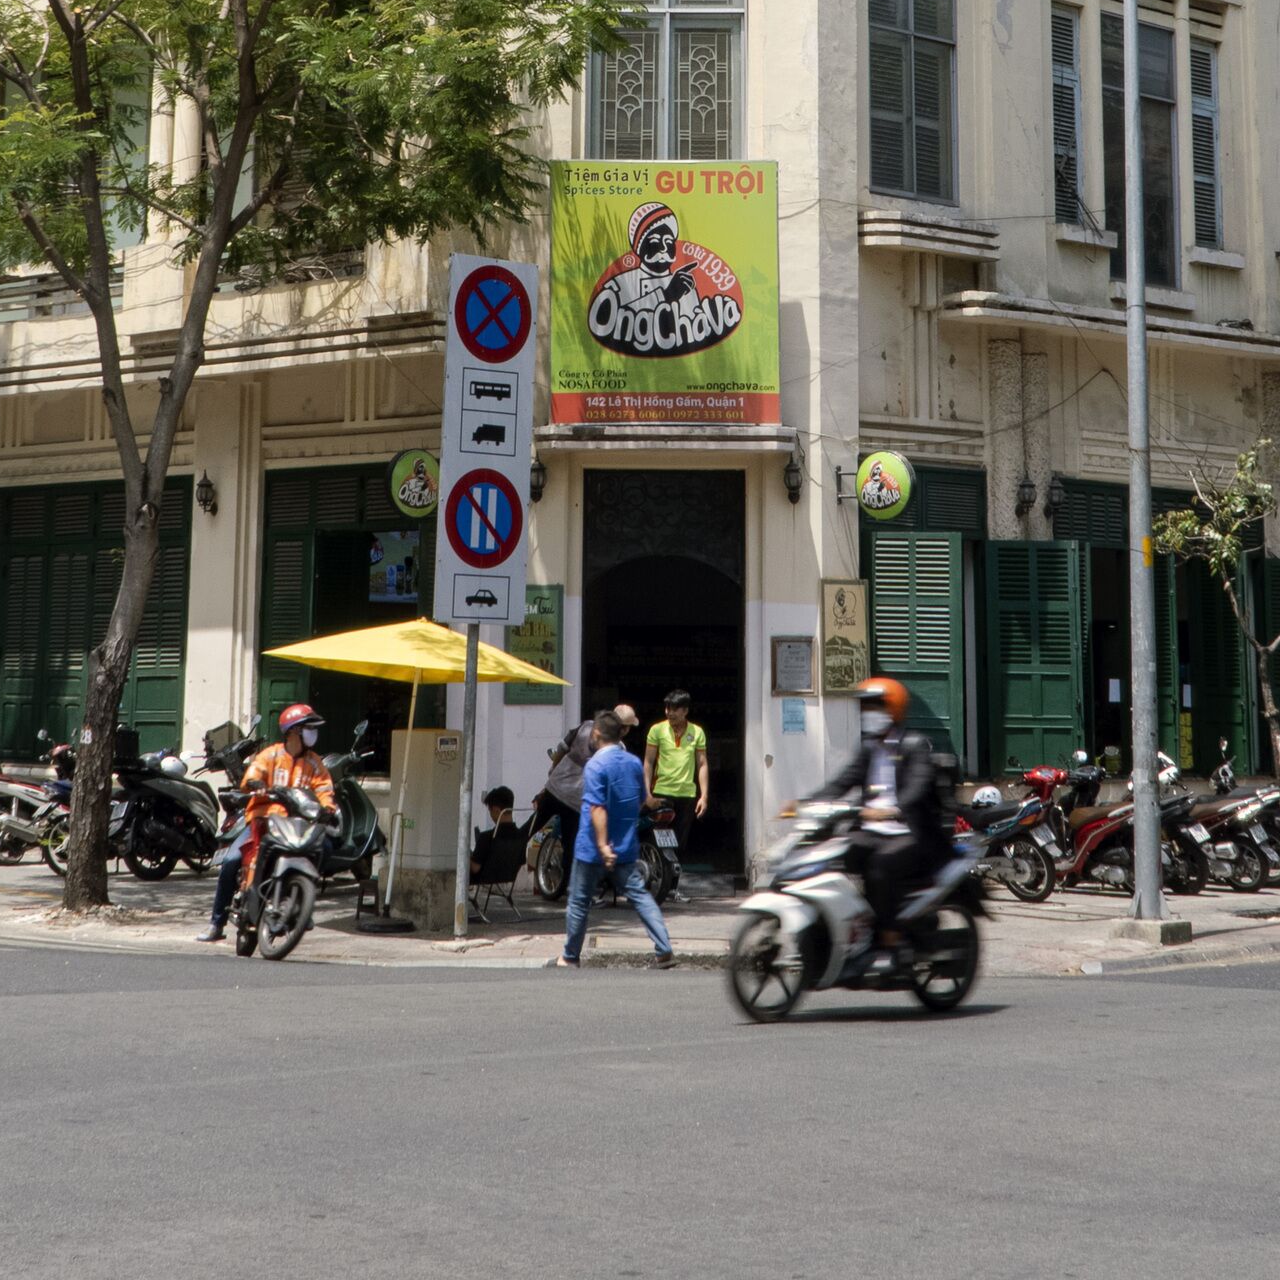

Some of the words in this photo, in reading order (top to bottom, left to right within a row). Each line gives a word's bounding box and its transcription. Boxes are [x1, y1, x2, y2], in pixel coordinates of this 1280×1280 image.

[565, 168, 599, 186] Tiệm
[604, 168, 629, 182] Gia
[633, 168, 649, 186] Vị
[655, 170, 694, 194] GU
[700, 164, 764, 200] TRỘI
[564, 184, 605, 197] Spices
[609, 184, 643, 195] Store
[699, 253, 736, 291] 1939
[559, 379, 627, 390] NOSAFOOD
[686, 380, 775, 393] www.ongchava.com
[585, 396, 607, 407] 142
[608, 396, 622, 407] Lê
[623, 396, 641, 409] Thị
[643, 395, 673, 409] Hồng
[675, 395, 704, 409] Gấm,
[706, 396, 736, 409] Quận
[738, 397, 744, 407] 1
